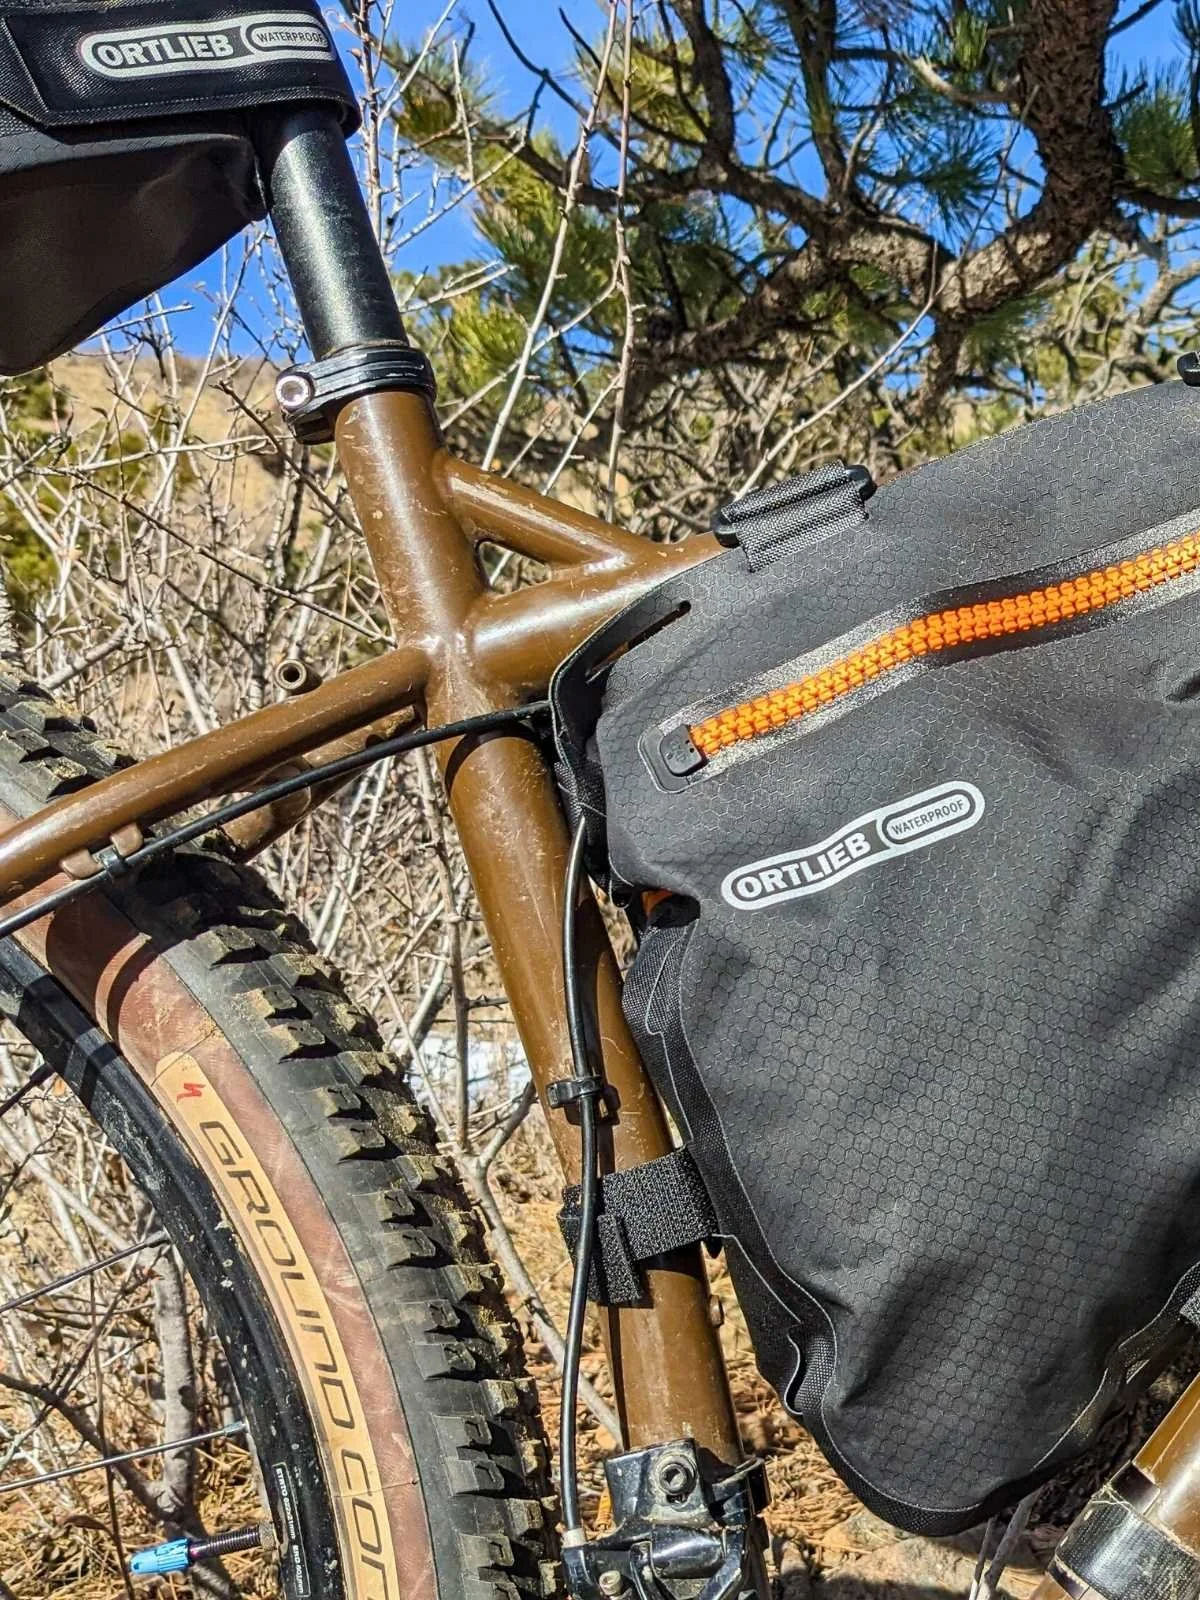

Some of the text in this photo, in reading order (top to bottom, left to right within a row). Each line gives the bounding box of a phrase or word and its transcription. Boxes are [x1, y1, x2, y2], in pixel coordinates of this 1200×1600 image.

[96, 32, 325, 66] ORTLIEB WATERPROOF
[736, 800, 965, 899] ORTLIEB WATERPROOF
[200, 1120, 355, 1430] GROUND
